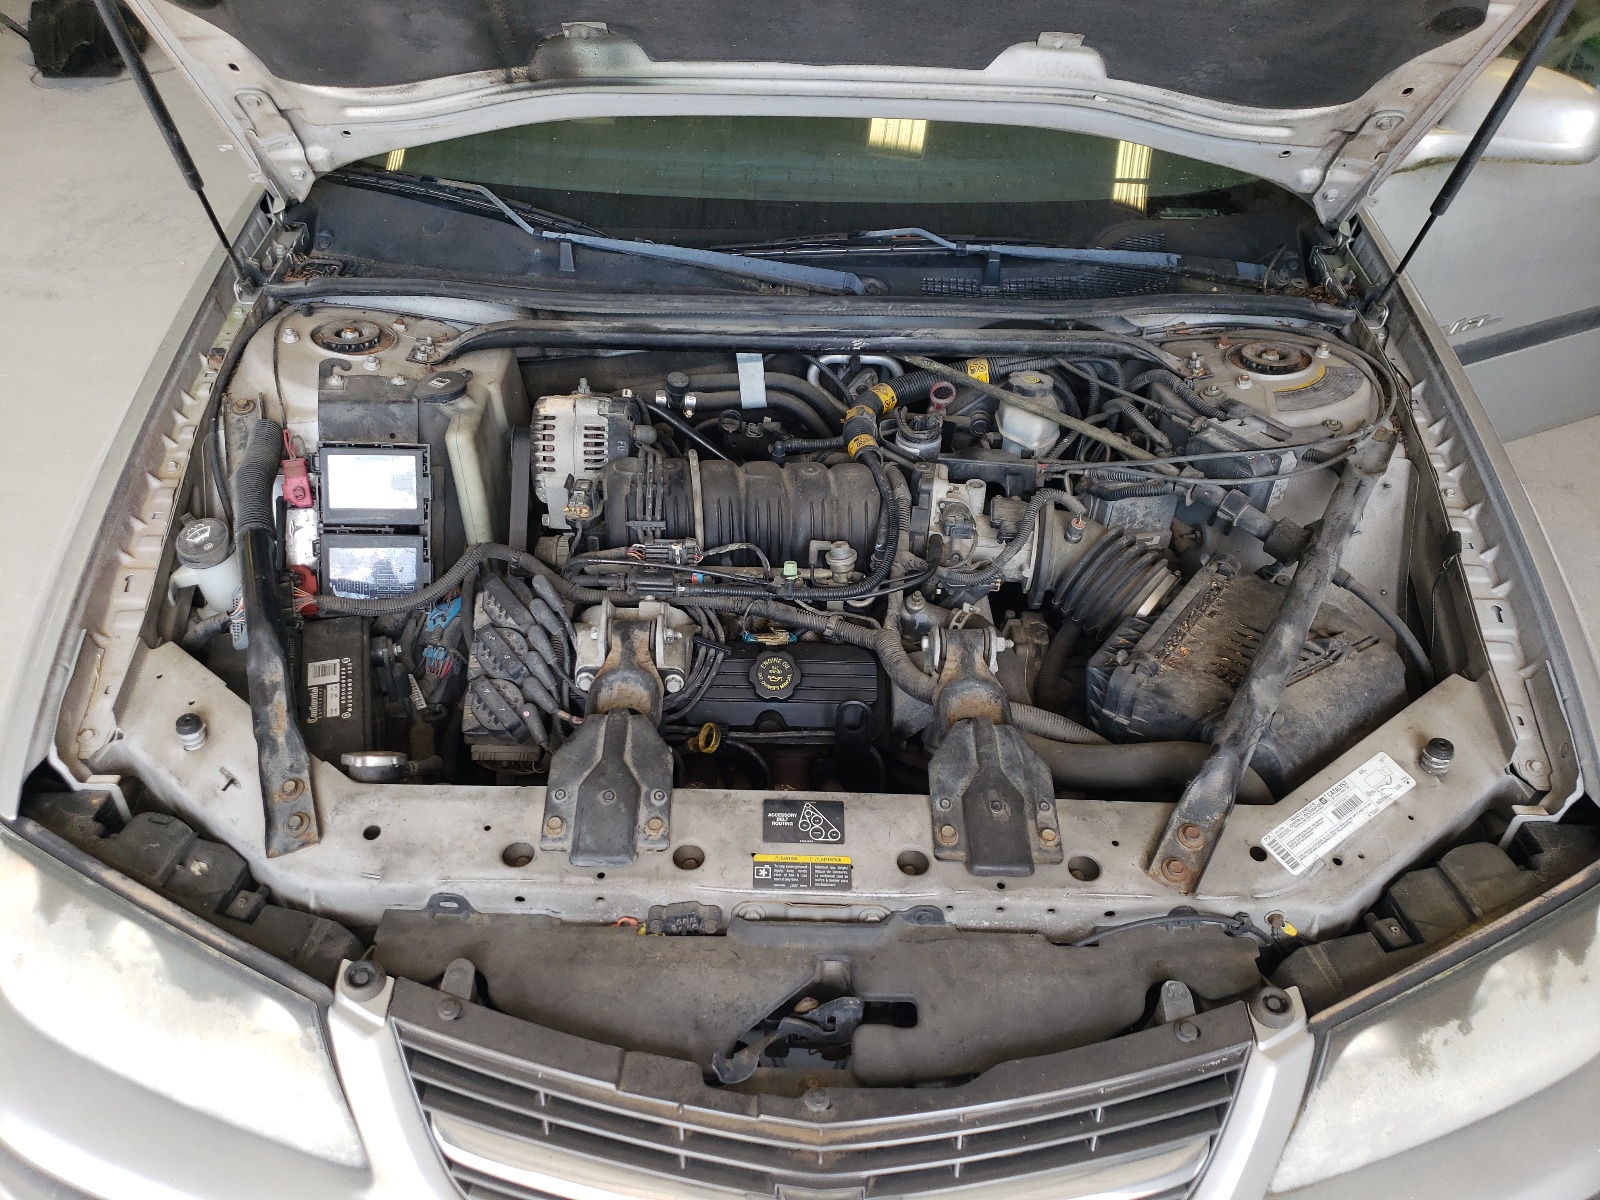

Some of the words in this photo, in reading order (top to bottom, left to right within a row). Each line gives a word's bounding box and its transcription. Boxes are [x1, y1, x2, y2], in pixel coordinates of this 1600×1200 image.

[760, 657, 782, 669] ENGINE
[307, 687, 319, 724] Continental
[1327, 780, 1349, 798] CATALYST
